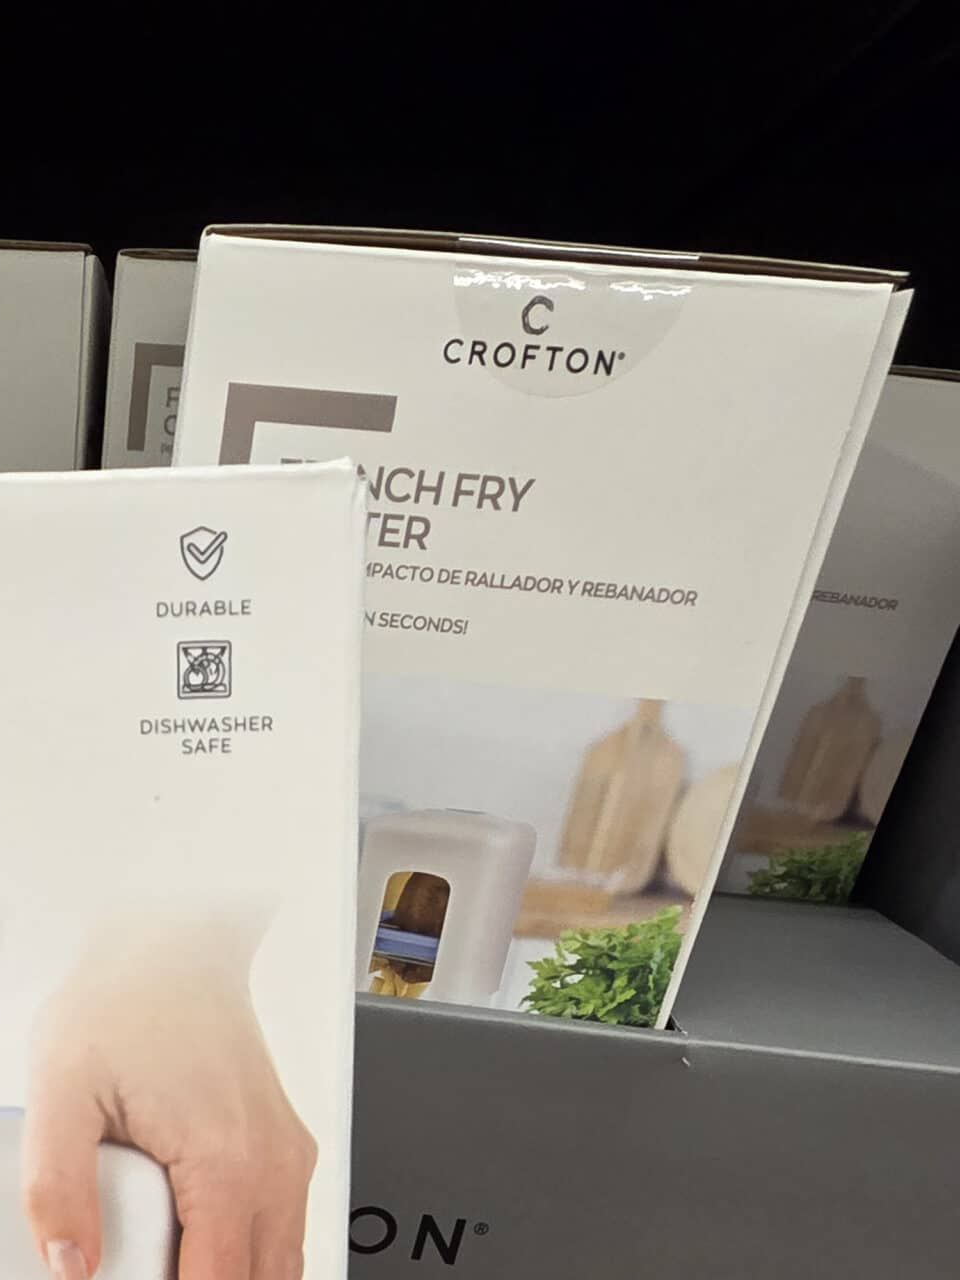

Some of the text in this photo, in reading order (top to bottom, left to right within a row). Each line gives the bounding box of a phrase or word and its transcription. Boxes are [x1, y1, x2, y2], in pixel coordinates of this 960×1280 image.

[451, 472, 536, 512] FRY
[437, 568, 462, 585] DE
[464, 570, 563, 595] RALLADOR
[567, 580, 580, 596] Y
[581, 581, 698, 606] REBANADOR
[156, 599, 252, 618] DURABLE
[378, 611, 468, 635] SECONDS!
[140, 716, 273, 735] DISHWASHER
[181, 738, 232, 754] SAFE
